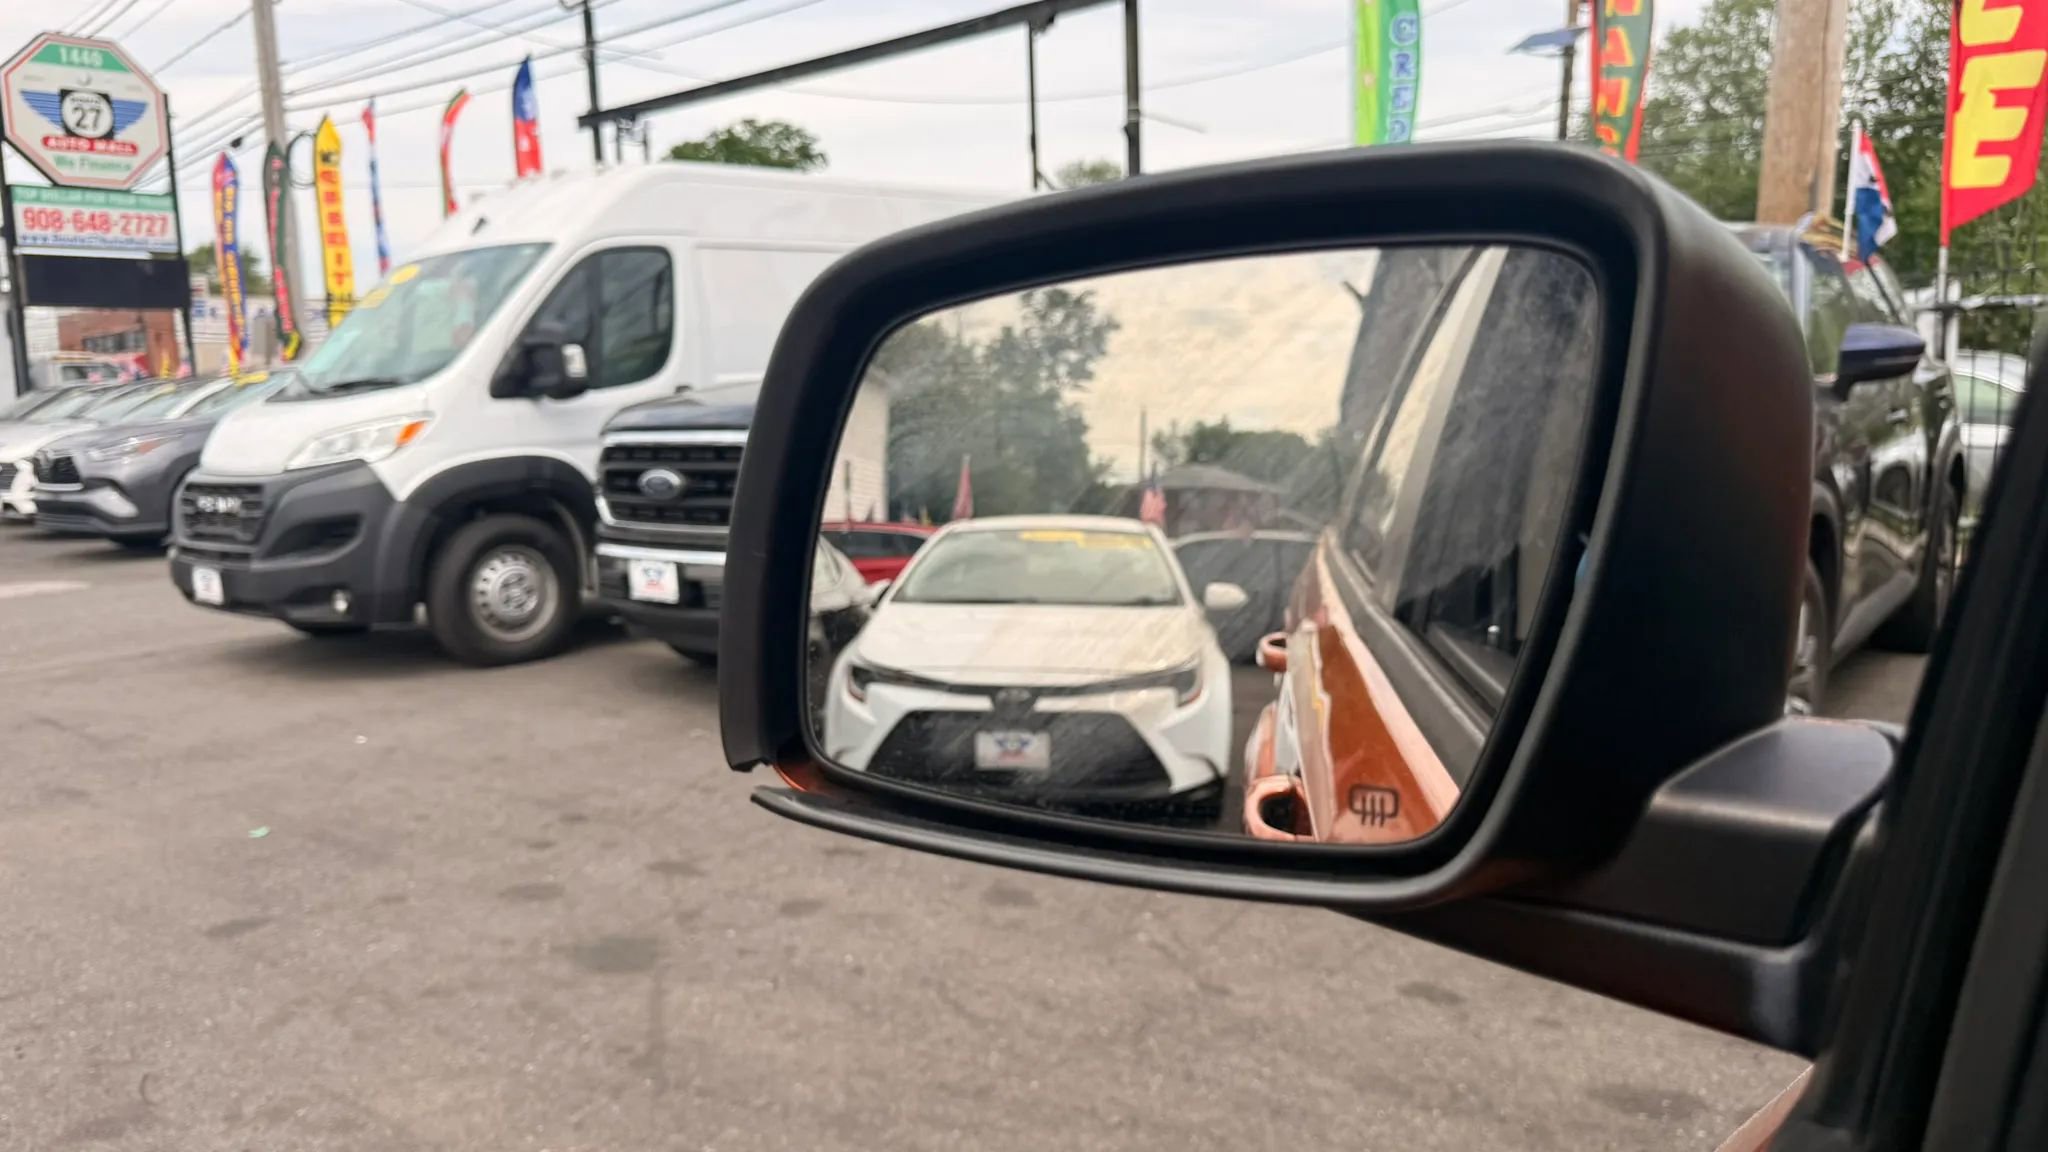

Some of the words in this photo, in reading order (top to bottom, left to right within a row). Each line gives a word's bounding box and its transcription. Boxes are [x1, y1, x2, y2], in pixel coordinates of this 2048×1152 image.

[72, 105, 102, 131] 27
[46, 136, 90, 151] AUTO
[95, 140, 134, 155] MALL
[22, 206, 169, 237] 908-648-2727
